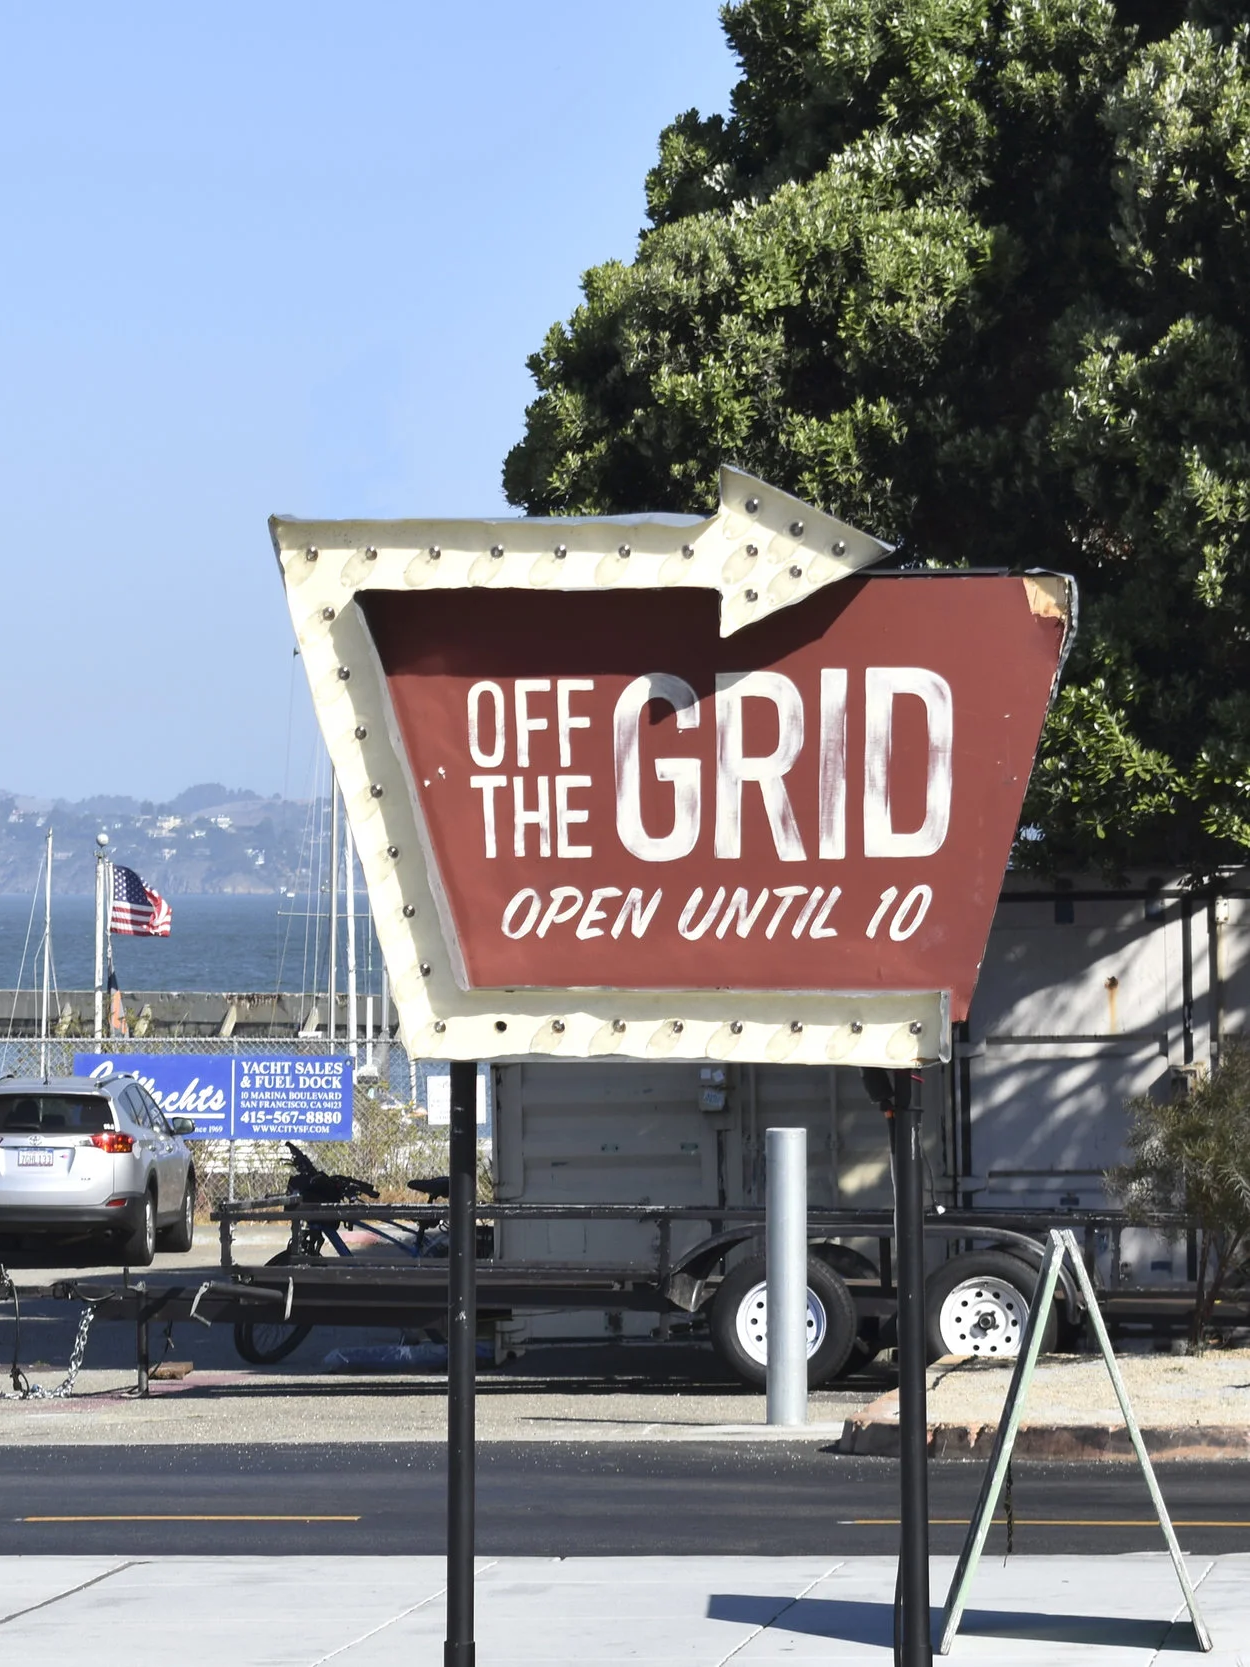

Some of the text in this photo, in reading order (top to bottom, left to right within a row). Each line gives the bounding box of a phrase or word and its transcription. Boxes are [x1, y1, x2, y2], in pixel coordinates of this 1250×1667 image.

[467, 679, 594, 768] OFF
[613, 667, 954, 862] GRID
[469, 775, 593, 859] THE
[501, 884, 933, 942] OPEN UNTIL 10
[241, 1061, 343, 1075] YACHT SALES
[240, 1075, 342, 1089] & FUEL DOCK
[241, 1091, 342, 1100] 10 MARINA BOULEVARD
[240, 1101, 342, 1109] SAN FRANCISCO, CA 94123
[240, 1110, 342, 1124] 415-567-8880
[252, 1125, 330, 1133] WWW.CITYSF.COM
